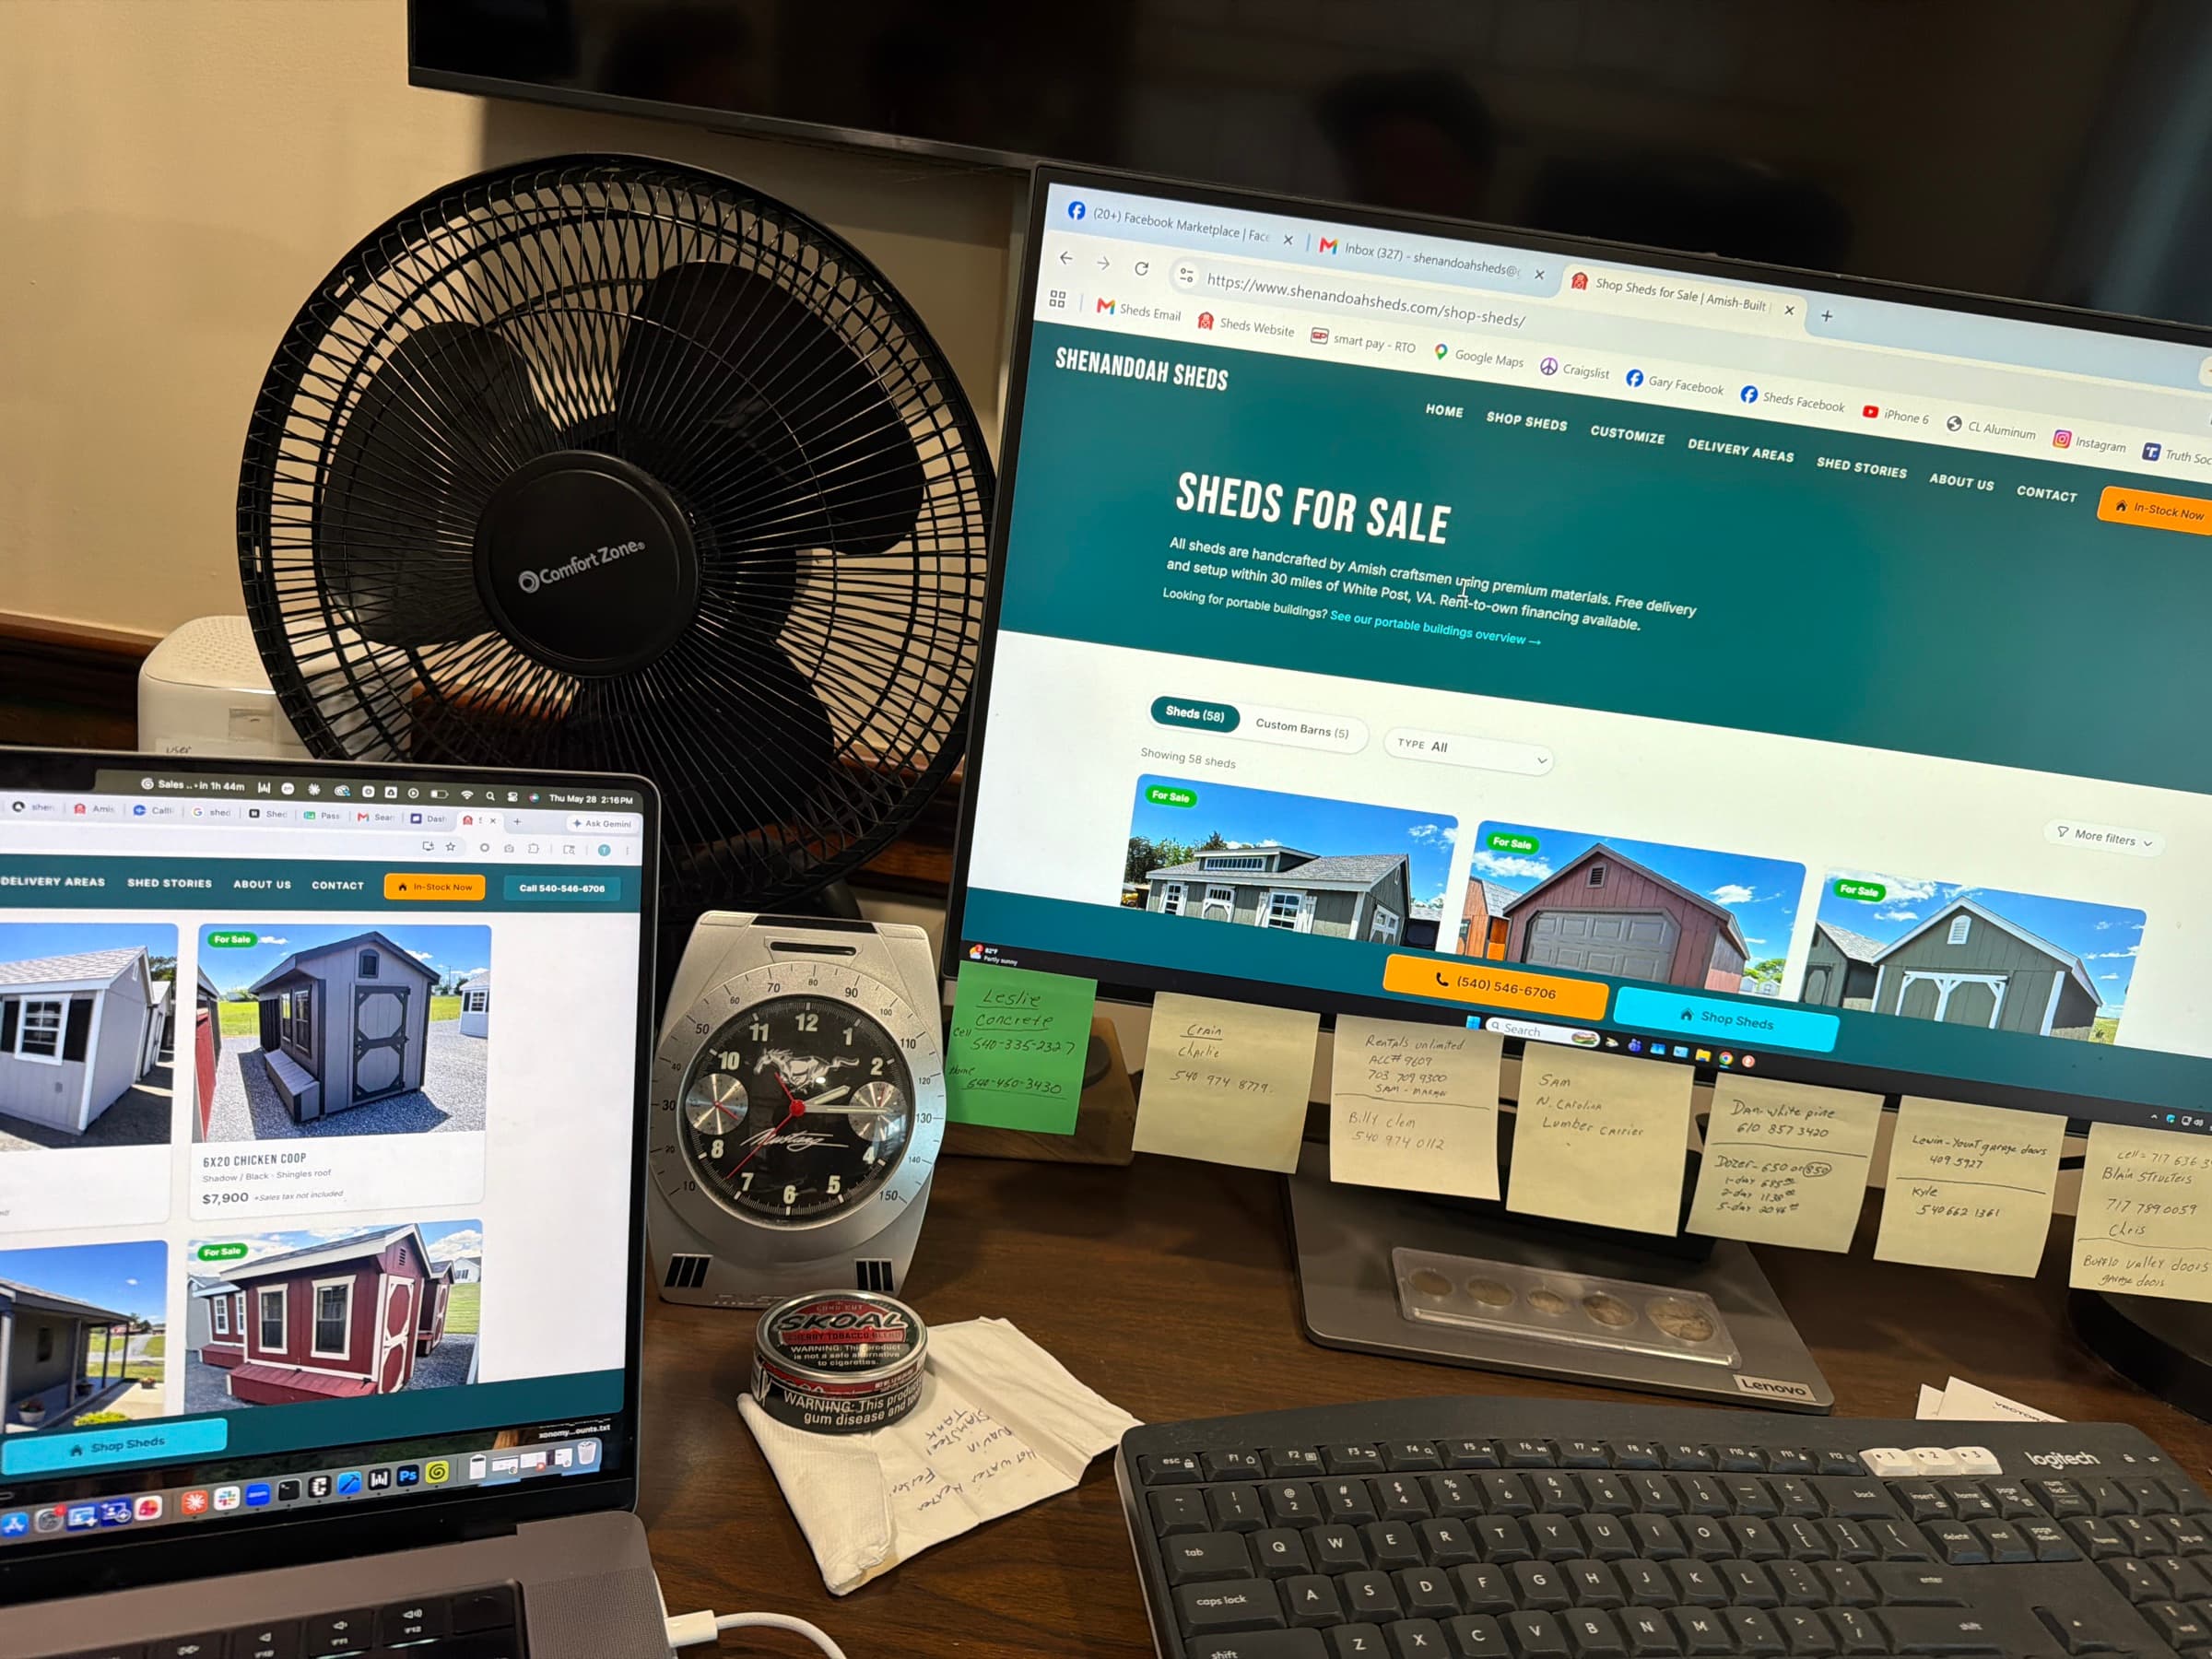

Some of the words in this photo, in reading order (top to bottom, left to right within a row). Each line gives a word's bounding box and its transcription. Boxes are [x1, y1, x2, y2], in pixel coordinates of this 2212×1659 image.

[1094, 207, 1122, 224] (20+)
[1124, 212, 1173, 229] Facebook
[1177, 219, 1240, 241] Marketplace
[1207, 273, 1526, 329] https://www.shenandoahsheds.com/shop-sheds/
[1596, 277, 1623, 293] Shop
[1626, 280, 1656, 298] Sheds
[1659, 287, 1675, 300] for
[1677, 288, 1699, 303] Sale
[1707, 294, 1767, 312] Amish-Built
[1121, 303, 1149, 319] Sheds
[1154, 307, 1182, 324] Email
[1220, 317, 1250, 333] Sheds
[1253, 321, 1295, 339] Website
[1455, 348, 1493, 367] Google
[1496, 354, 1524, 370] Maps
[1055, 347, 1169, 383] SHENANDOAH
[1173, 363, 1229, 391] SHEDS
[1563, 363, 1610, 381] Craigslist
[1649, 376, 1673, 391] Gary
[1676, 376, 1724, 397] Facebook
[1763, 391, 1794, 406] Sheds
[1797, 395, 1845, 414] Facebook
[1884, 406, 1919, 424] iPhone
[1922, 413, 1930, 425] 6
[1969, 420, 1982, 433] CL
[1984, 423, 2036, 441] Aluminum
[1425, 403, 1464, 418] HOME
[1487, 411, 1522, 426] SHOP
[1525, 416, 1568, 432] SHEDS
[1591, 425, 1665, 445] CUSTOMIZE
[1688, 438, 1749, 457] DELIVERY
[1753, 447, 1794, 463] AREAS
[1817, 456, 1851, 471] SHED
[1853, 461, 1908, 479] STORIES
[1930, 473, 1973, 489] ABOUT
[1977, 478, 1994, 492] US
[2017, 485, 2077, 503] CONTACT
[2076, 436, 2126, 455] Instagram
[1176, 472, 1283, 523] SHEDS
[1292, 488, 1357, 533] FOR
[1366, 498, 1452, 545] SALE
[2135, 502, 2178, 517] In-Stock
[2181, 509, 2205, 522] Now
[539, 553, 599, 584] Comfort
[1171, 536, 1186, 550] All
[1189, 539, 1226, 556] sheds
[1230, 546, 1248, 559] are
[1253, 547, 1326, 570] handcrafted
[1330, 558, 1345, 573] by
[1348, 559, 1386, 577] Amish
[1390, 566, 1452, 586] craftsmen
[1456, 574, 1489, 592] using
[1493, 580, 1547, 599] premium
[1551, 584, 1611, 606] materials.
[1616, 594, 1642, 610] Free
[1646, 598, 1697, 619] delivery
[1167, 558, 1190, 571] and
[1194, 562, 1228, 581] setup
[1231, 567, 1267, 582] within
[1271, 572, 1287, 585] 30
[1290, 575, 1323, 591] miles
[1326, 579, 1339, 592] of
[1343, 581, 1377, 598] White
[1382, 585, 1412, 605] Post,
[1417, 589, 1436, 606] VA.
[1441, 594, 1518, 616] Rent-to-own
[1522, 604, 1579, 625] financing
[1582, 612, 1641, 631] available.
[1163, 587, 1206, 606] Looking
[1208, 594, 1223, 607] for
[1226, 596, 1271, 615] portable
[1273, 602, 1328, 621] buildings?
[1330, 609, 1351, 622] See
[1354, 615, 1371, 626] our
[1374, 615, 1420, 633] portable
[1423, 620, 1472, 640] buildings
[1476, 630, 1526, 645] overview
[1166, 704, 1200, 720] Sheds
[1203, 709, 1225, 724] (58)
[1255, 718, 1297, 734] Custom
[1300, 724, 1332, 737] Barns
[1335, 727, 1349, 740] (5)
[1398, 738, 1425, 750] TYPE
[1430, 740, 1447, 754] All
[1140, 747, 1185, 765] Showing
[1189, 754, 1202, 765] 58
[1205, 757, 1236, 770] sheds
[549, 794, 564, 804] Thu
[568, 794, 583, 806] May
[585, 794, 596, 804] 28
[1152, 790, 1168, 802] For
[1171, 792, 1190, 804] Sale
[585, 819, 599, 829] Ask
[601, 819, 631, 830] Gemini
[2076, 829, 2102, 842] More
[2106, 831, 2136, 847] filters
[0, 877, 61, 887] DELIVERY
[65, 877, 105, 887] AREAS
[127, 877, 159, 888] SHED
[163, 878, 212, 888] STORIES
[234, 879, 272, 889] ABOUT
[276, 880, 291, 889] US
[312, 881, 364, 890] CONTACT
[414, 882, 450, 892] In-Stock
[453, 883, 473, 892] Now
[520, 884, 536, 893] Call
[539, 885, 606, 894] 540-546-6706
[214, 934, 229, 945] For
[231, 934, 251, 945] Sale
[768, 982, 780, 994] 70
[845, 987, 858, 998] 90
[1457, 974, 1491, 991] (540)
[1494, 981, 1557, 1000] 546-6706
[982, 988, 1041, 1006] Leslie
[696, 1023, 710, 1035] 50
[795, 1014, 818, 1032] 12
[1505, 1022, 1541, 1038] Search
[1701, 1011, 1733, 1027] Shop
[1735, 1017, 1774, 1030] Sheds
[749, 1023, 770, 1042] 11
[900, 1038, 916, 1049] 110
[204, 1158, 229, 1168] 6X20
[234, 1155, 276, 1167] CHICKEN
[281, 1153, 306, 1163] COOP
[203, 1193, 249, 1206] $7,900
[879, 1190, 899, 1201] 150
[778, 1312, 909, 1331] SKOAL
[1742, 1378, 1806, 1397] Lenovo
[805, 1412, 831, 1425] gum
[836, 1409, 885, 1426] disease
[91, 1442, 124, 1453] Shop
[127, 1438, 165, 1448] Sheds
[2025, 1451, 2100, 1469] logitech
[1196, 1596, 1220, 1607] caps
[1223, 1594, 1246, 1606] lock
